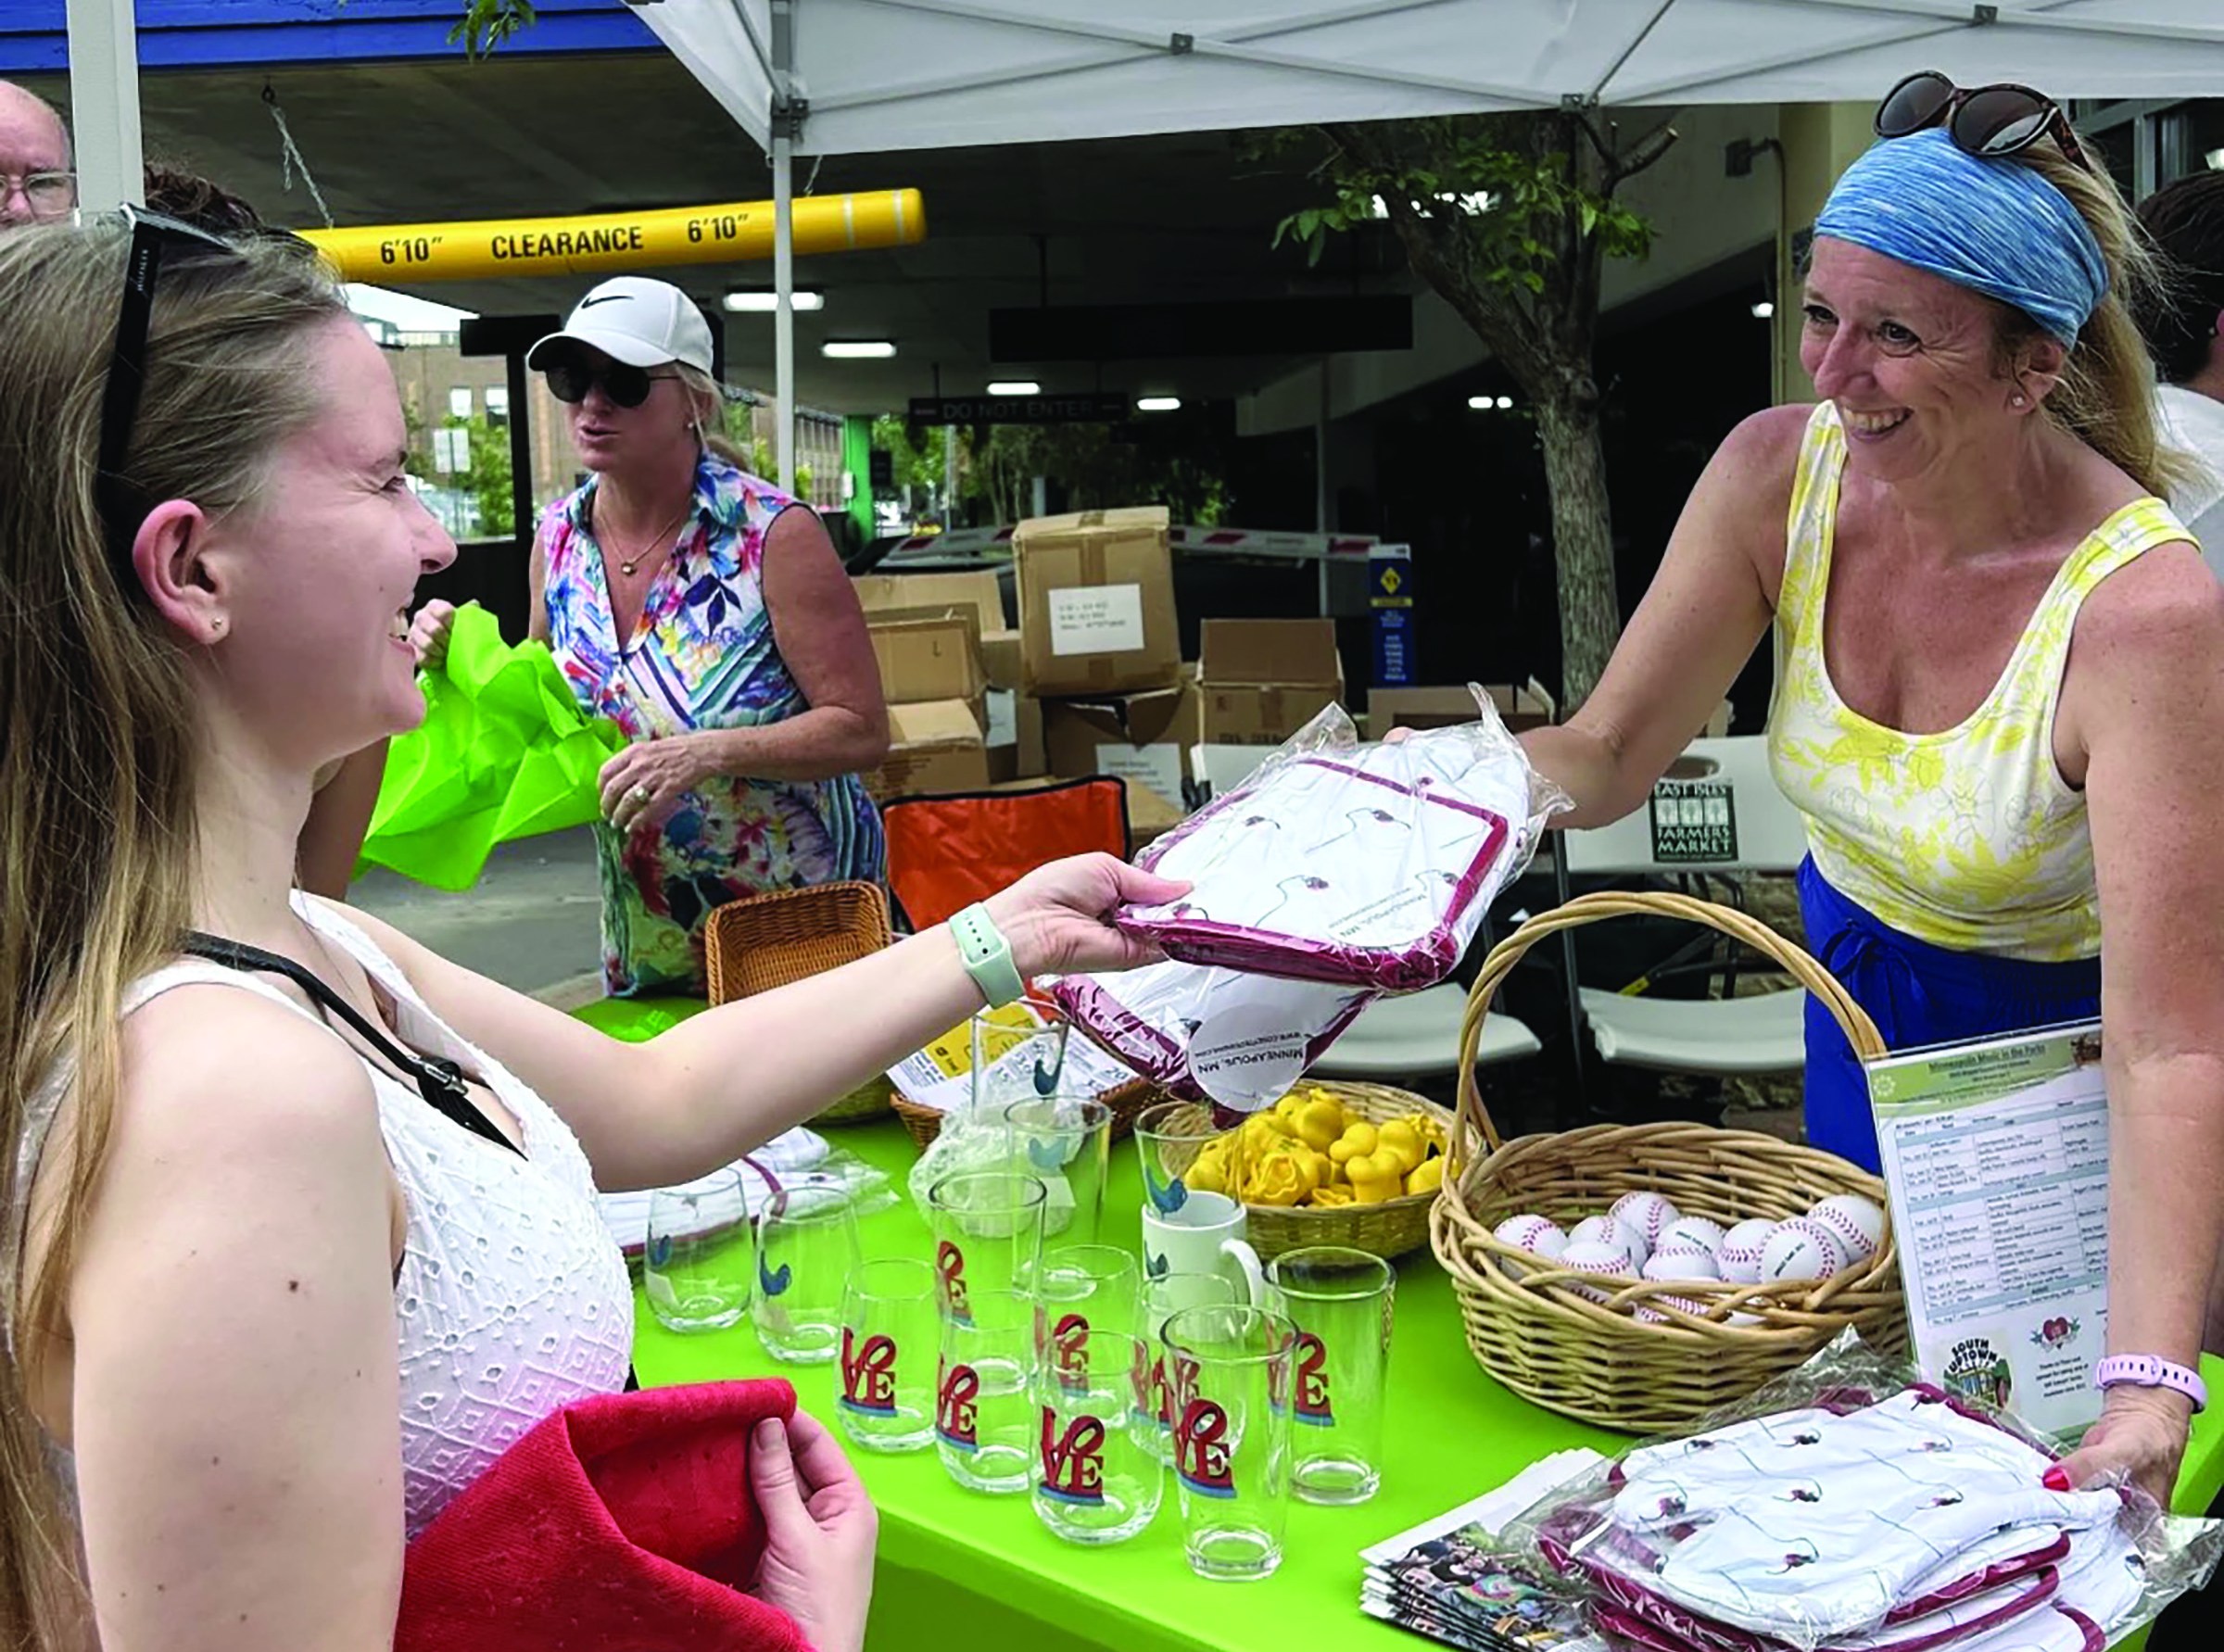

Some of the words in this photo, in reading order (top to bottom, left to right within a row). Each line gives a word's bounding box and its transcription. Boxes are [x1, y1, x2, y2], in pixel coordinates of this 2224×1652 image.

[381, 235, 443, 265] 6'10"
[491, 226, 644, 259] CLEARANCE
[688, 213, 749, 244] 6'10"
[942, 404, 971, 420] DO
[978, 401, 1020, 418] NOT
[1026, 398, 1094, 417] ENTER
[1658, 824, 1731, 840] FARMERS
[1657, 838, 1730, 853] MARKET
[1197, 1062, 1220, 1074] MN
[1952, 1338, 1990, 1357] SOUTH
[1948, 1349, 1998, 1373] UPTOWN
